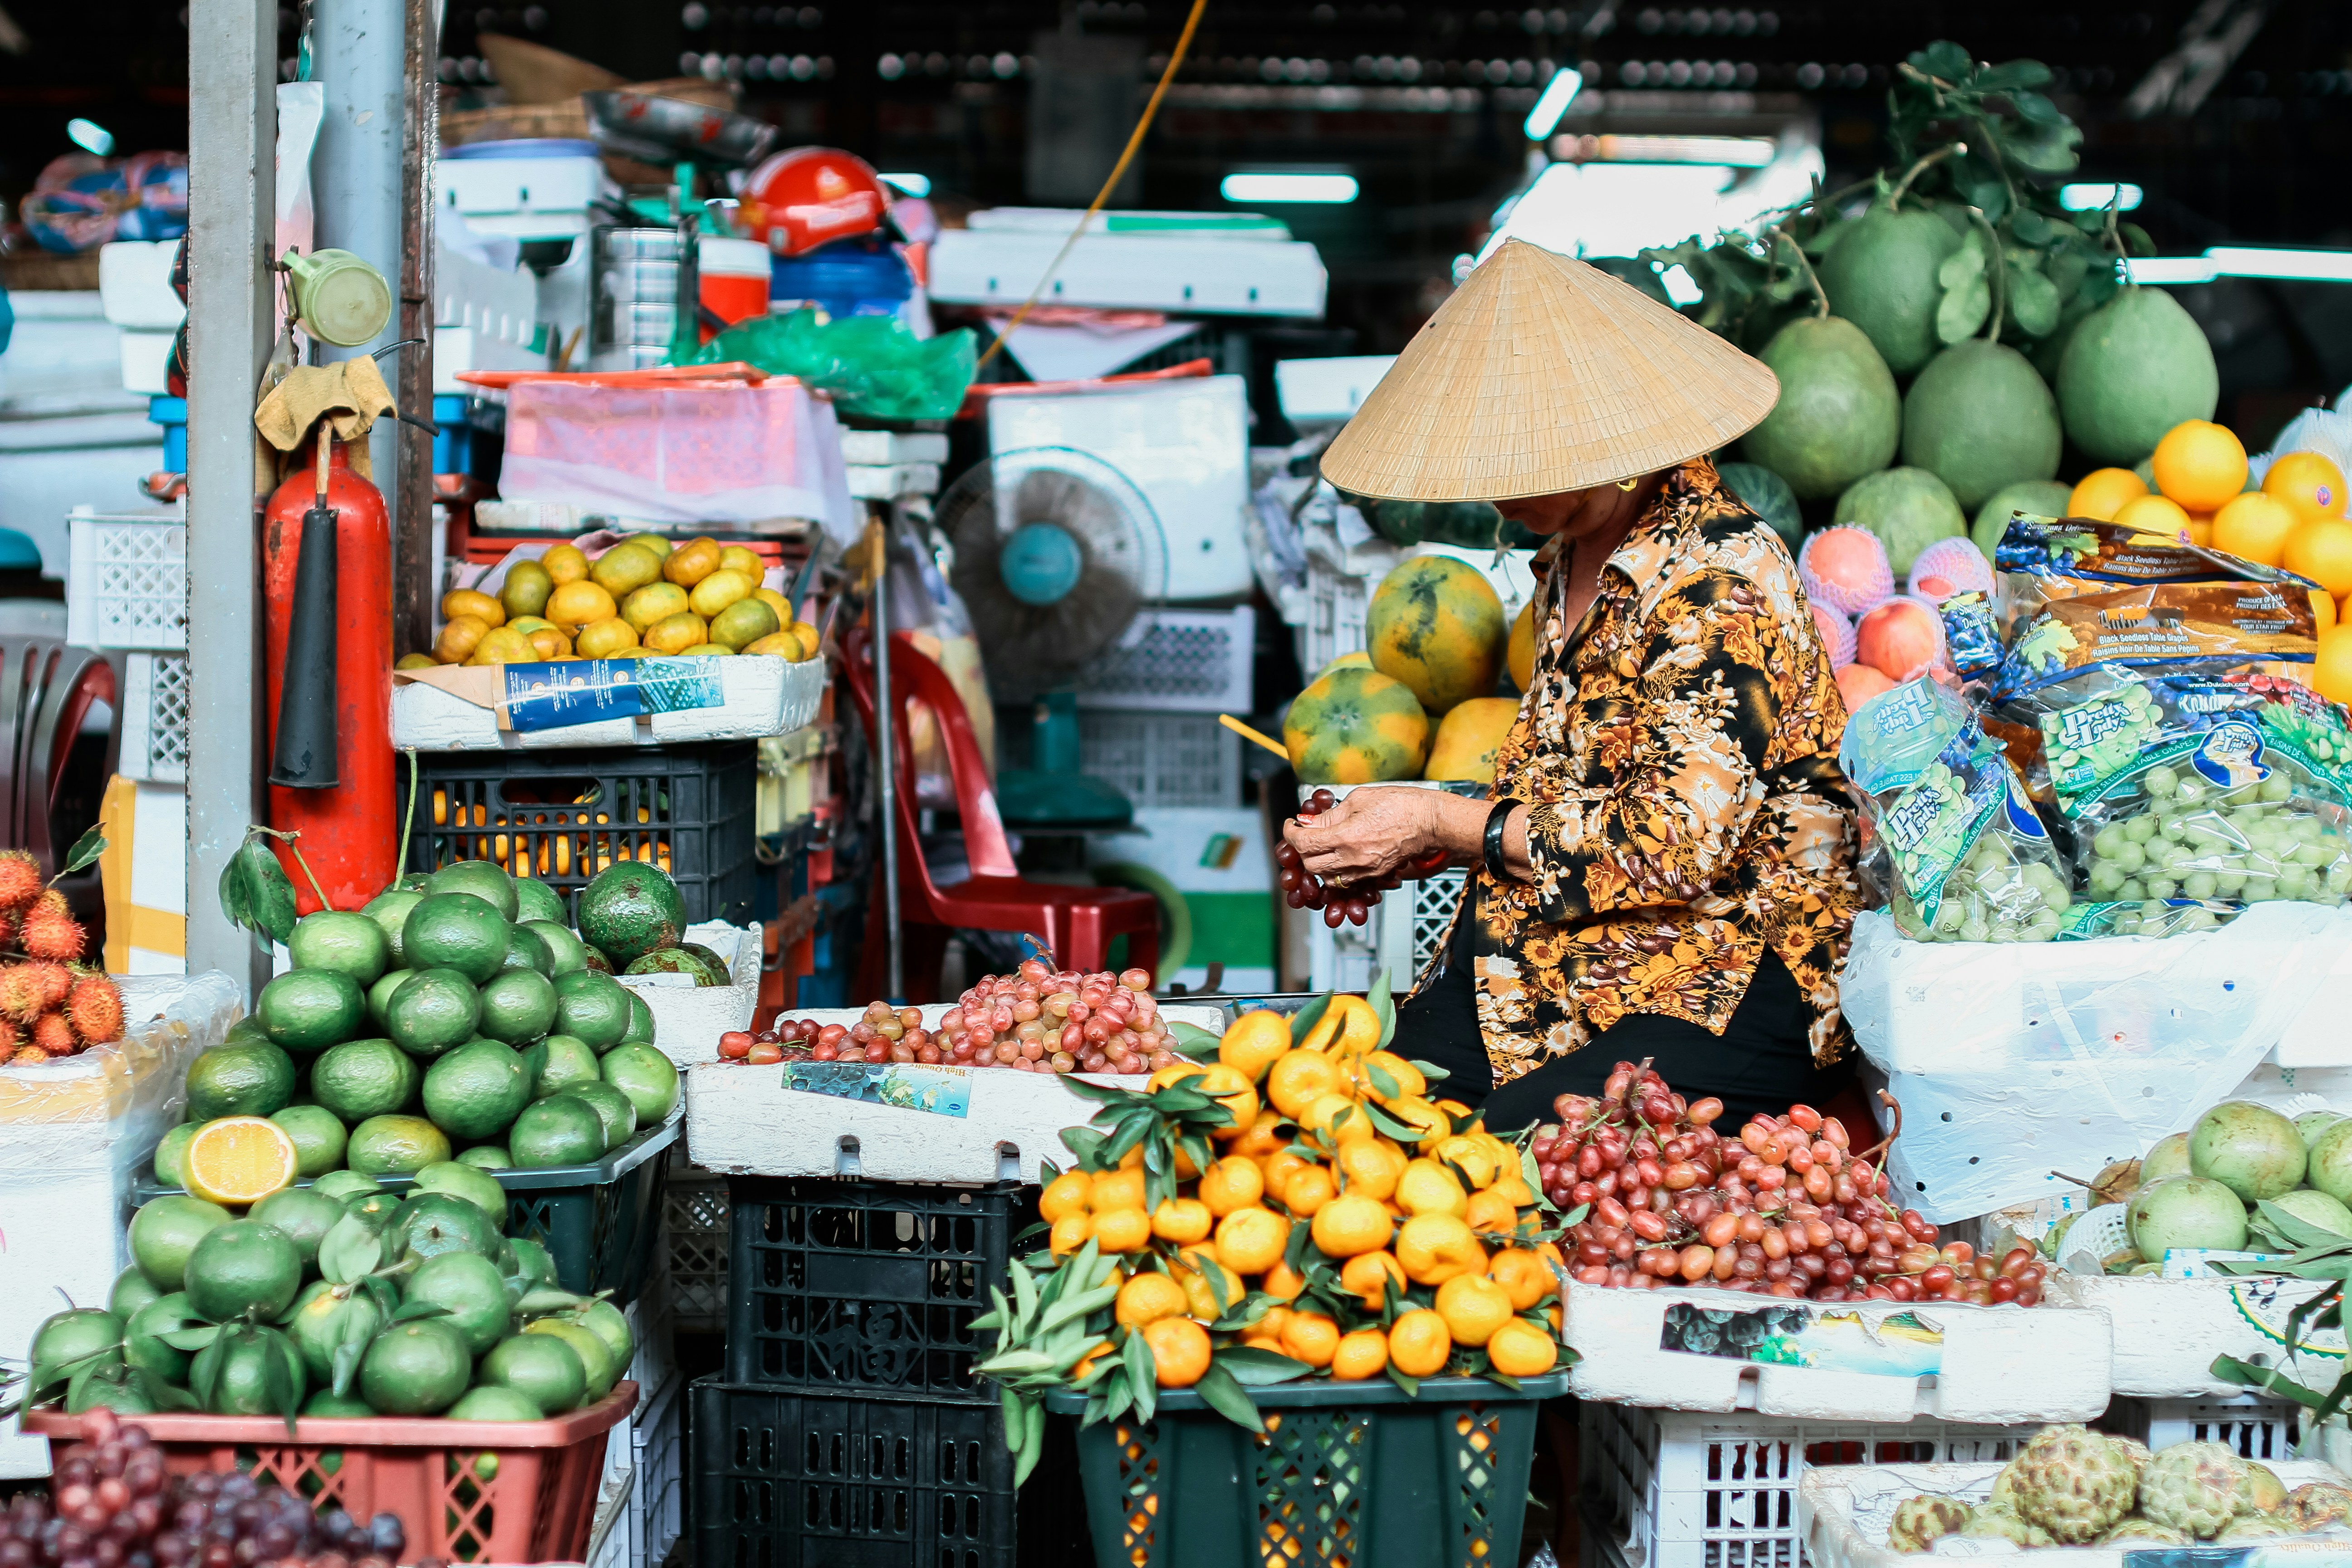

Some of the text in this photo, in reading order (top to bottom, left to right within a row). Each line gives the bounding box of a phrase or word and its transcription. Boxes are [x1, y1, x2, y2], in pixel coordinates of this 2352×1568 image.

[1958, 597, 1990, 615] Sweet and
[1962, 617, 1981, 629] Doux
[2099, 632, 2189, 644] Black Seedless Table Grapes
[2092, 647, 2118, 657] Raisins
[2120, 645, 2133, 653] Noir
[2134, 645, 2143, 653] De
[2144, 644, 2161, 653] Table
[2161, 644, 2177, 653] Sans
[2063, 702, 2128, 737] Pretty
[2078, 716, 2122, 747] Lady
[2215, 727, 2255, 745] Pretty
[2269, 738, 2292, 754] RAISINS
[2075, 786, 2101, 810] GREEN
[2100, 763, 2136, 788] SEEDLESS
[2136, 751, 2161, 766] TABLE
[2161, 739, 2195, 755] GRAPES
[1889, 787, 1941, 842] Pretty
[1903, 803, 1936, 846] Lady
[1928, 880, 1942, 908] GREEN
[1966, 822, 1983, 845] TABLE
[1981, 794, 2002, 822] GRAPES
[2075, 906, 2101, 933] EEDLESS
[945, 1067, 966, 1077] High
[822, 1300, 913, 1384] 福
[2279, 1544, 2321, 1553] Quality
